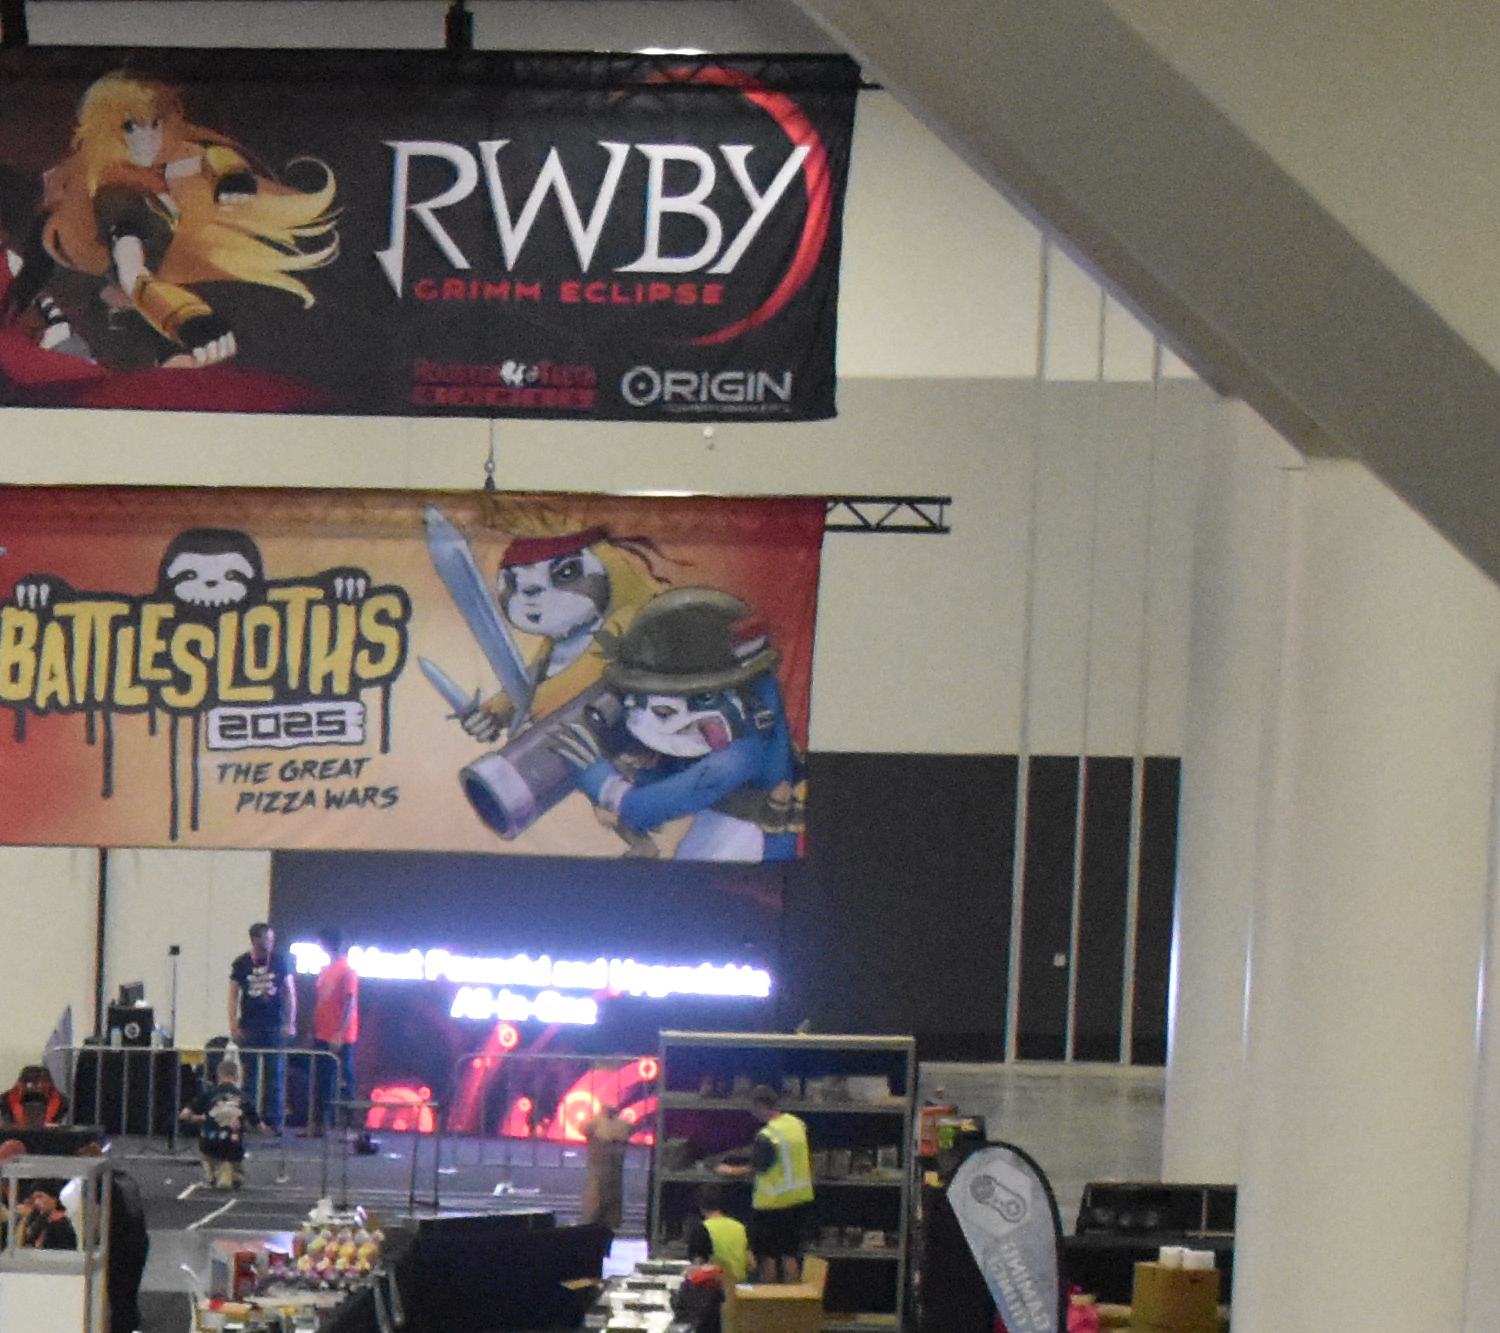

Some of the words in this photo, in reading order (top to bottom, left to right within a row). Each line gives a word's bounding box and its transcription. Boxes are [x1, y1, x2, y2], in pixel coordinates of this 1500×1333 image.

[374, 139, 810, 298] RWBY
[414, 278, 541, 301] GRIMM
[559, 281, 724, 306] ECLIPSE
[621, 366, 793, 406] ORIGIN
[218, 710, 348, 740] 2025
[216, 760, 273, 784] THE
[278, 757, 372, 782] GREAT
[235, 791, 318, 814] PIZZA
[323, 785, 400, 811] WARS
